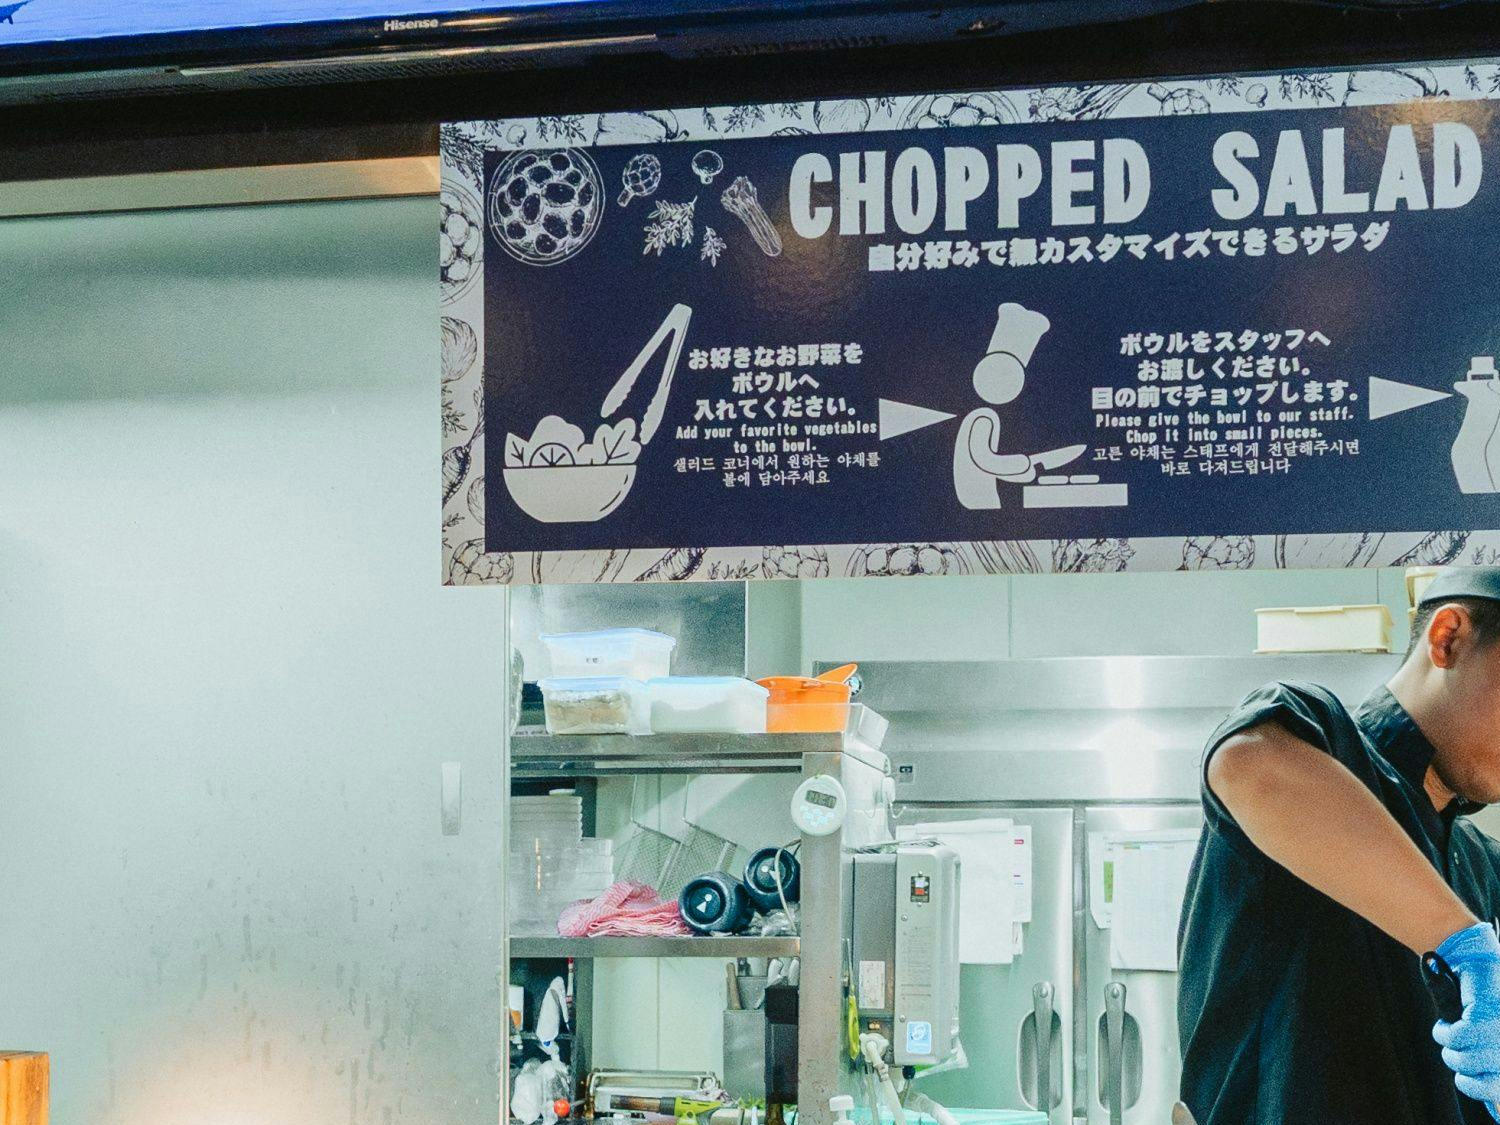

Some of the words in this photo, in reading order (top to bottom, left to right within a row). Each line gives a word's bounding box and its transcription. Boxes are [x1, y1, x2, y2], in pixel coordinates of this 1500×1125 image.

[384, 19, 439, 31] Hisense
[789, 138, 1151, 239] CHOPPED
[1211, 122, 1483, 220] SALAD
[1119, 329, 1332, 356] ボウルをスタッフへ
[688, 342, 864, 370] お好きなお野菜を
[1137, 355, 1311, 382] お渡しください。
[732, 371, 820, 394] ボウルへ
[1091, 379, 1359, 410] 目の前でチョップします。
[693, 395, 856, 422] 入れてください。
[1096, 412, 1142, 428] Please
[1149, 411, 1180, 427] give
[1187, 411, 1210, 426] the
[1217, 410, 1247, 425] bowl
[1256, 409, 1272, 423] to
[1279, 409, 1302, 423] our
[1310, 406, 1354, 421] staff.
[676, 426, 698, 440] Add
[704, 427, 733, 440] your
[741, 423, 798, 439] favorite
[804, 421, 878, 436] vegetables
[1126, 429, 1157, 445] Chop
[1165, 428, 1179, 442] it
[1188, 428, 1218, 442] into
[1225, 426, 1262, 440] small
[1271, 426, 1323, 441] pieces.
[733, 441, 748, 453] to
[755, 440, 776, 453] the
[782, 438, 817, 452] bowl.
[1092, 446, 1123, 462] 고른
[1183, 442, 1259, 459] 스태프에게
[1268, 439, 1360, 458] 전달해주시면
[673, 458, 716, 472] 샐러드
[722, 455, 778, 472] 코너에서
[787, 453, 830, 469] 원하는
[837, 452, 882, 468] 야채를
[1161, 460, 1191, 477] 바로
[1200, 457, 1291, 475] 다져드립니다
[758, 470, 830, 487] 담아주세요
